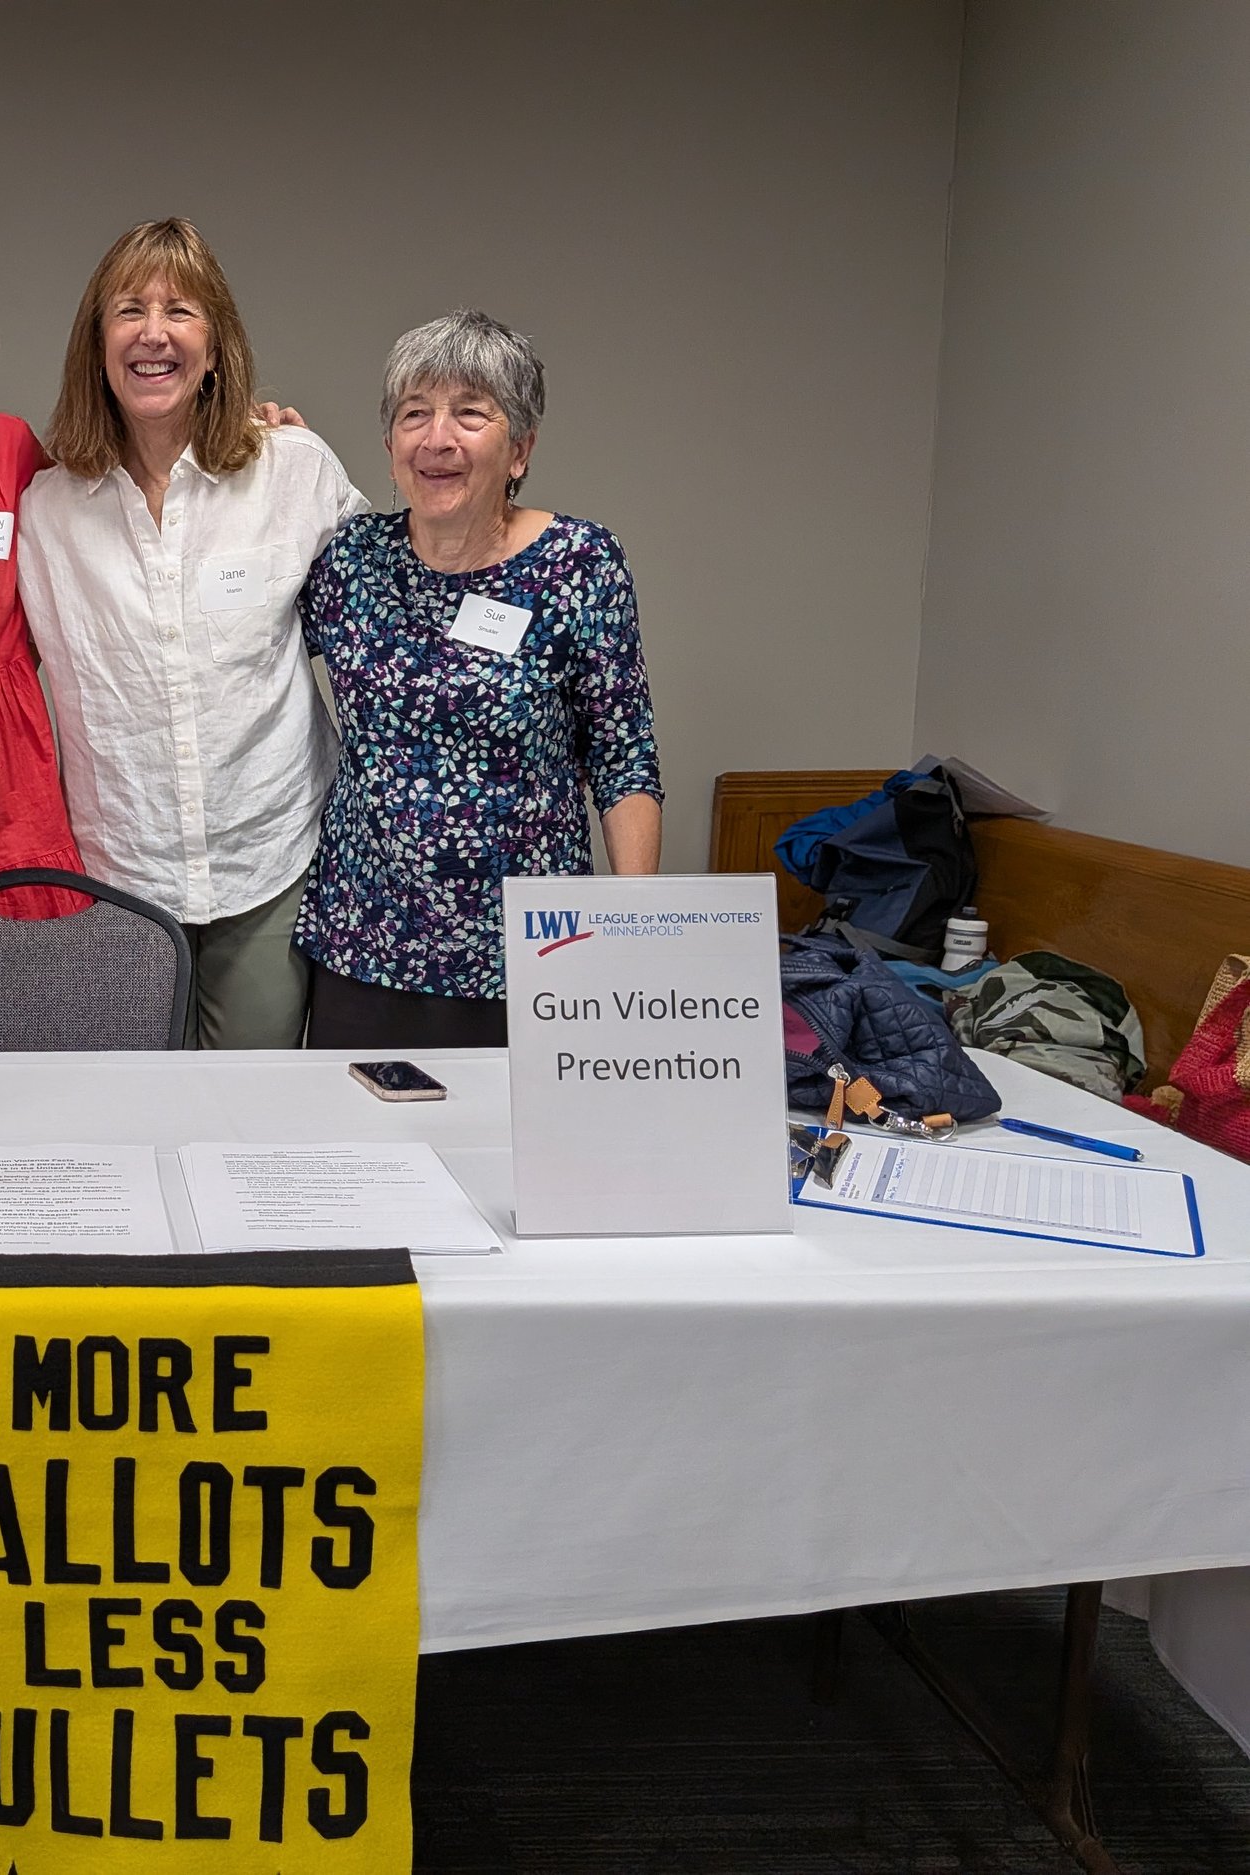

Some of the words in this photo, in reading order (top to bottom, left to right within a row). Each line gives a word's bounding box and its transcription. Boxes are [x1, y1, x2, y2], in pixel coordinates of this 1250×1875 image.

[219, 569, 246, 581] Jane
[483, 608, 506, 622] Sue
[524, 911, 581, 940] LWV
[588, 913, 638, 925] LEAGUE
[640, 915, 655, 925] OF
[656, 913, 708, 924] WOMEN
[602, 925, 684, 937] MINNEAPOLIS
[532, 991, 601, 1021] Gun
[612, 988, 760, 1020] Violence
[557, 1050, 741, 1081] Prevention
[11, 1334, 271, 1434] MORE
[23, 1597, 267, 1694] LESS
